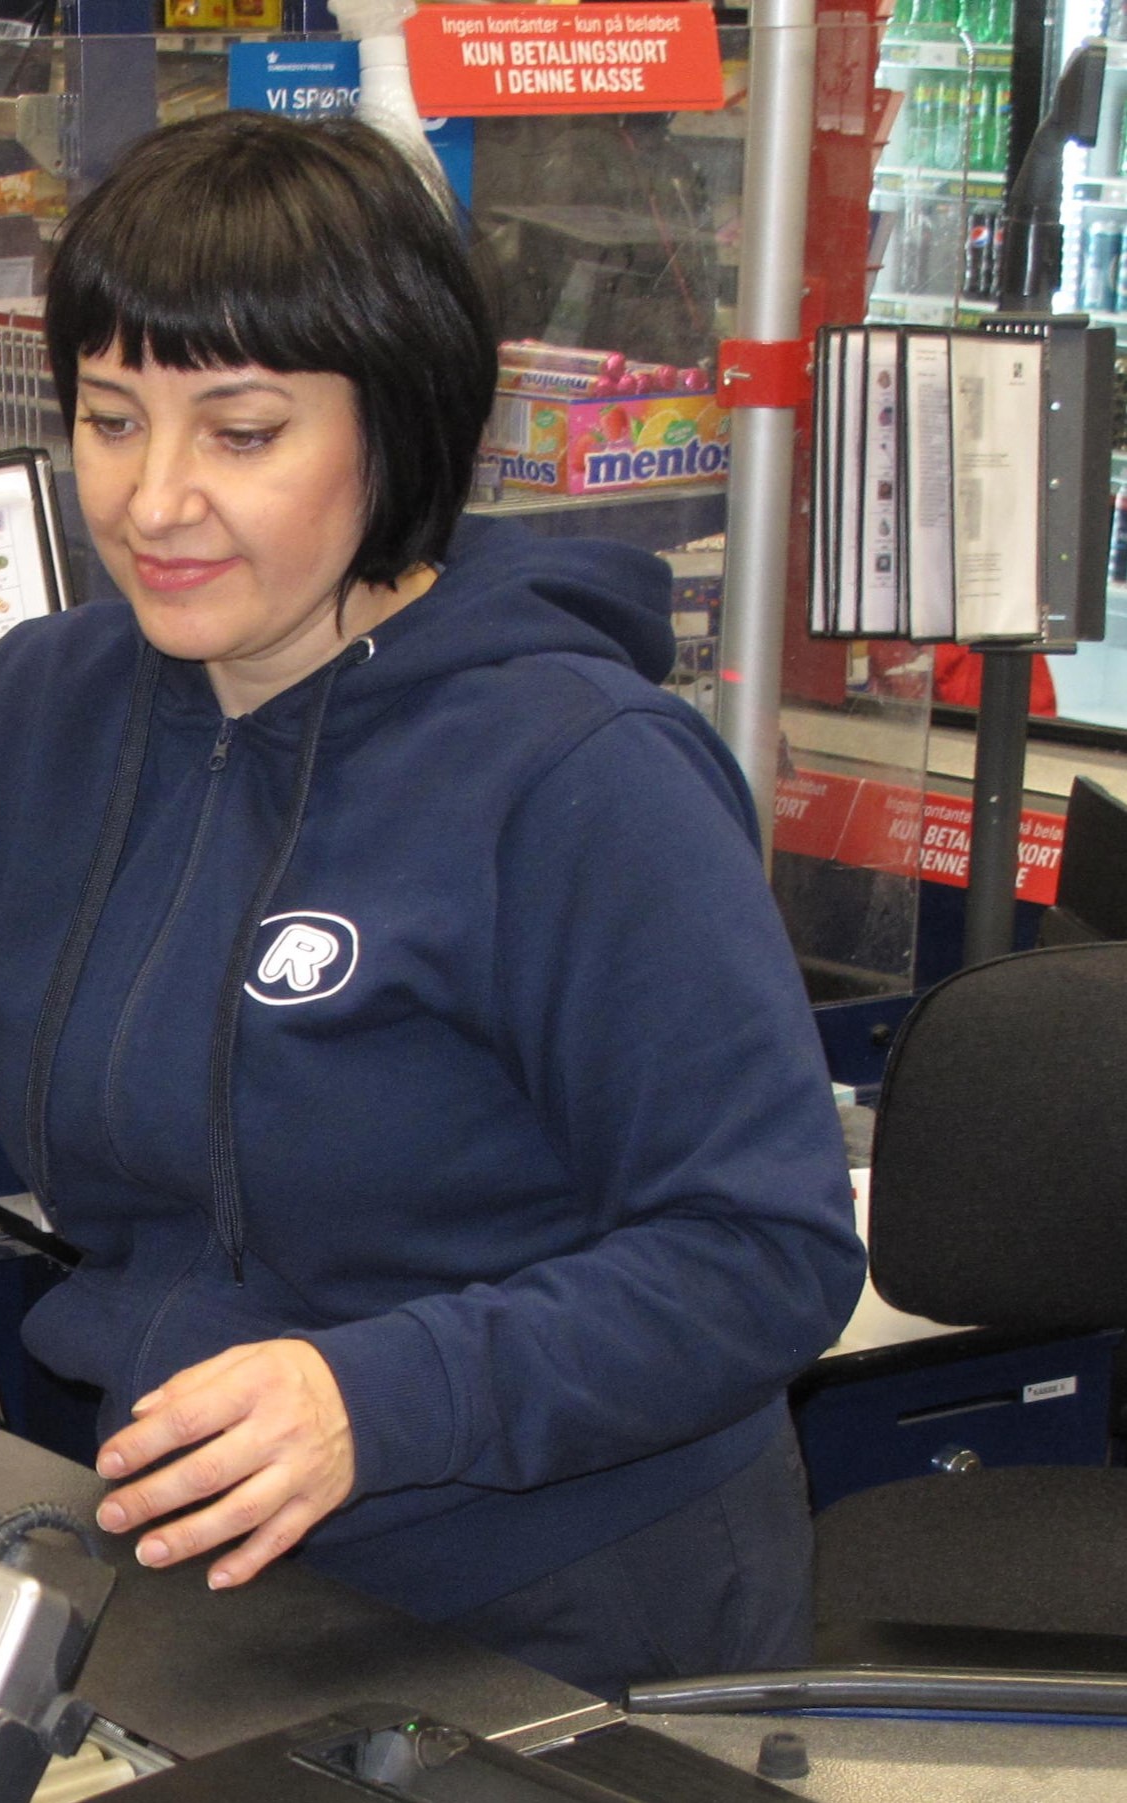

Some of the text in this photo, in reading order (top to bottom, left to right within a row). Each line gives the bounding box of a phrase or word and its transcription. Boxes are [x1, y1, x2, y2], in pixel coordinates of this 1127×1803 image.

[442, 16, 484, 37] Ingen
[487, 15, 558, 34] kontanter
[574, 15, 601, 33] kun
[604, 14, 624, 35] på
[626, 14, 680, 33] beløbet
[461, 39, 668, 66] KUN BETALINGSKORT
[495, 67, 645, 94] I DENNE KASSE
[266, 88, 287, 110] VI
